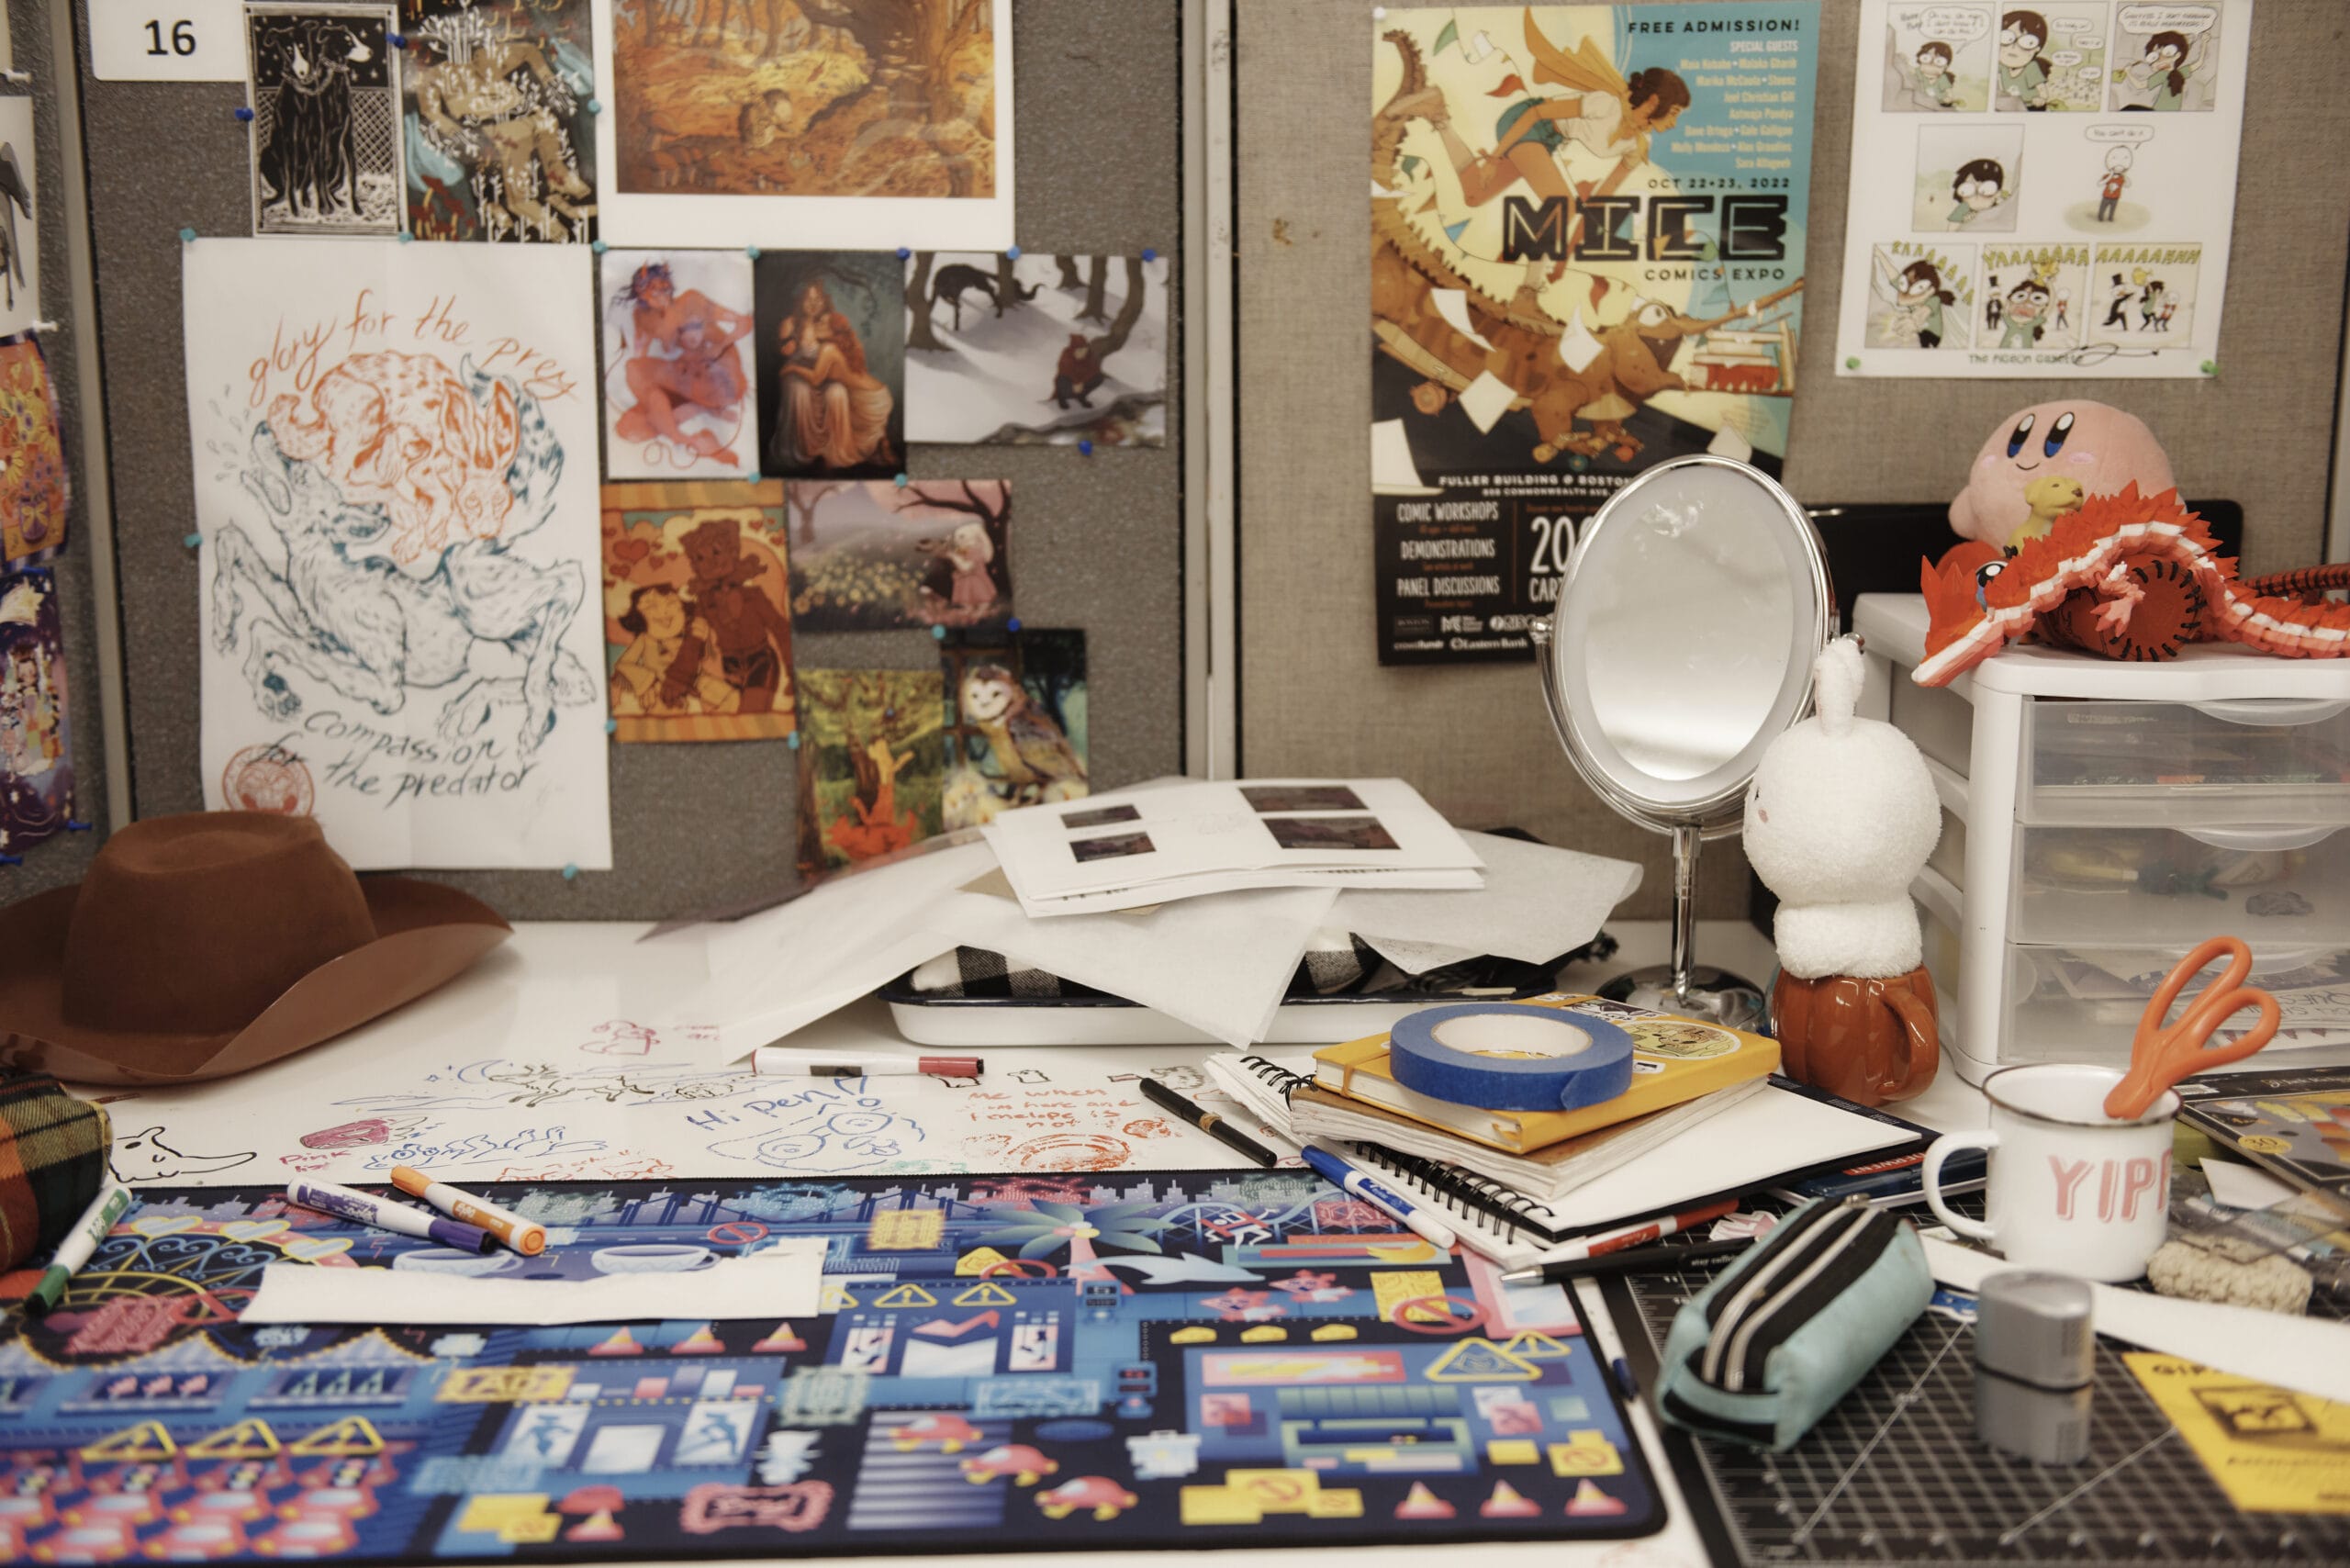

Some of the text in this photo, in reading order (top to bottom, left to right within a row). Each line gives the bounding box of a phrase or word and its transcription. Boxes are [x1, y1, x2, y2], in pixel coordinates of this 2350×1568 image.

[1628, 18, 1800, 33] FREE ADMISSION!
[145, 19, 196, 56] 16
[1729, 39, 1799, 52] SPECIAL GUESTS
[1648, 178, 1682, 189] OCT
[1750, 177, 1790, 189] 2022
[1503, 195, 1789, 263] MICE
[1644, 268, 1785, 282] COMICS EXPO
[249, 288, 580, 409] glory for the prey
[1438, 476, 1490, 487] FULLER
[1493, 474, 1559, 486] BUILDING
[1504, 487, 1587, 498] COMMONWEALTH
[1395, 501, 1500, 523] COMIC WORKSHOPS
[1400, 538, 1496, 560] DEMONSTRATIONS
[1395, 576, 1501, 598] PANEL DISCUSSIONS
[1501, 637, 1528, 649] Bank
[244, 730, 540, 811] for the predator
[686, 1107, 741, 1131] Hi
